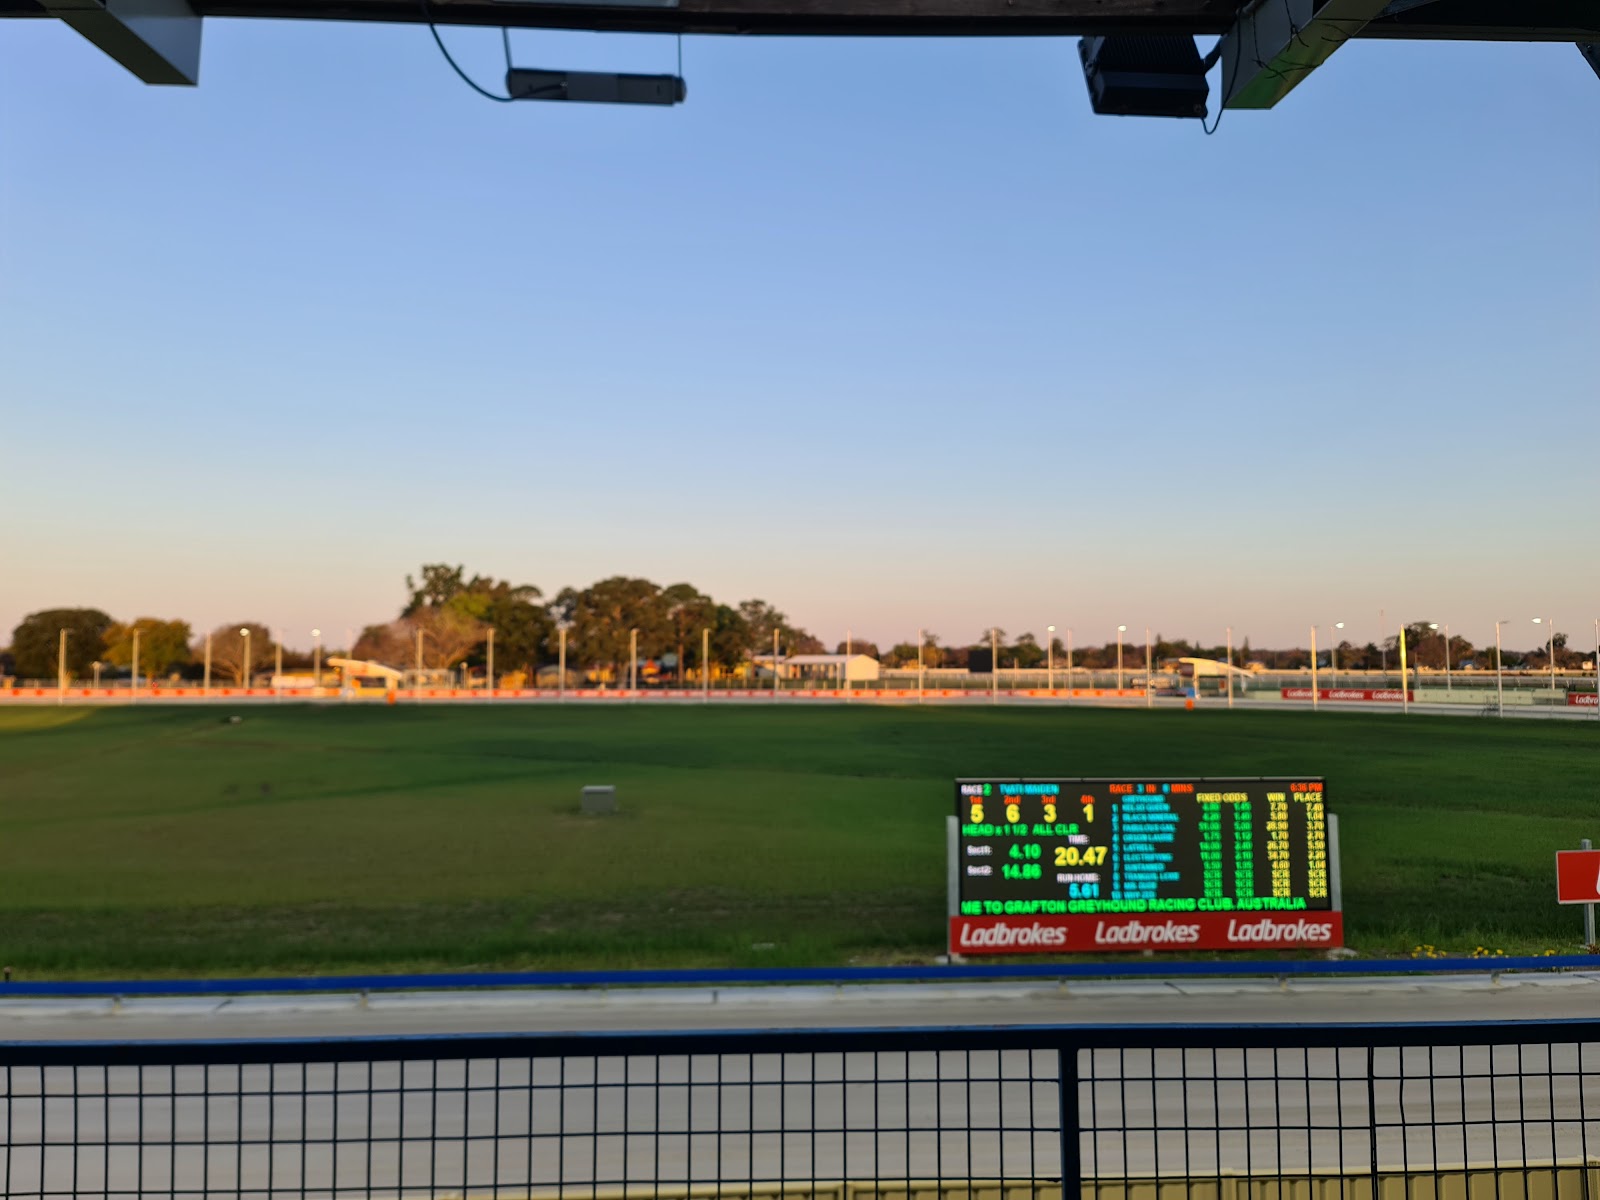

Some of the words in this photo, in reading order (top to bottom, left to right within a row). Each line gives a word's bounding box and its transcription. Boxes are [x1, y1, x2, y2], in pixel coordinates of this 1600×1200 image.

[961, 784, 983, 796] RACE
[1109, 783, 1133, 793] RACE
[1146, 783, 1157, 793] IN
[1171, 783, 1194, 793] MINS
[1308, 782, 1323, 793] PM
[1004, 795, 1021, 804] 2nd
[1041, 795, 1056, 804] 3rd
[1196, 793, 1222, 803] FIXED
[1222, 792, 1249, 803] ODDS
[1266, 792, 1286, 802] WIN
[1293, 792, 1323, 803] PLACE
[970, 803, 984, 823] 5
[1006, 803, 1020, 823] 6
[1043, 803, 1057, 823] 3
[1083, 803, 1094, 823] 1
[962, 824, 995, 836] HEAD
[1032, 823, 1055, 836] ALL
[1008, 843, 1042, 859] 4.10
[1054, 846, 1108, 866] 20.47
[1056, 873, 1073, 883] RUN
[961, 901, 982, 915] ME
[983, 900, 1004, 914] TO
[1004, 899, 1067, 914] GRAFTON
[1068, 898, 1147, 913] GREYHOUND
[1148, 898, 1197, 912] RACING
[1236, 896, 1307, 911] AUSTRALIA
[960, 921, 1068, 947] Ladbrokes
[1095, 919, 1200, 945] Ladbrokes
[1227, 917, 1333, 942] Ladbrokes
